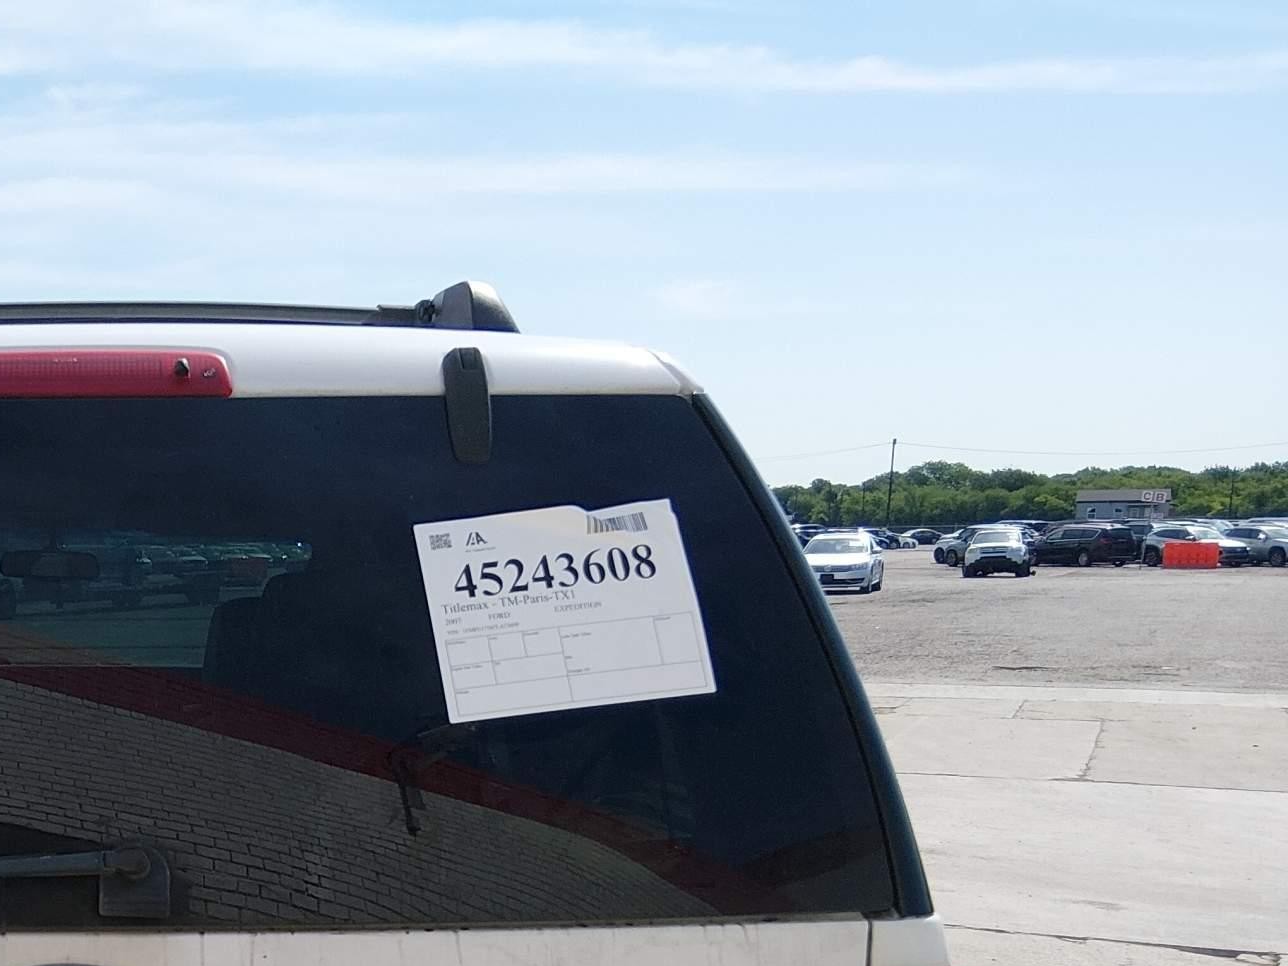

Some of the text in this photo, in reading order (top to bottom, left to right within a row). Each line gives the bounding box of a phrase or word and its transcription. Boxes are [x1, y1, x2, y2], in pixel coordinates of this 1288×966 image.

[454, 543, 657, 598] 45243608
[441, 602, 489, 615] Titlemax
[499, 590, 576, 608] TM-Paris-TX1
[488, 612, 511, 621] FORD
[554, 601, 602, 613] EXPEDITION
